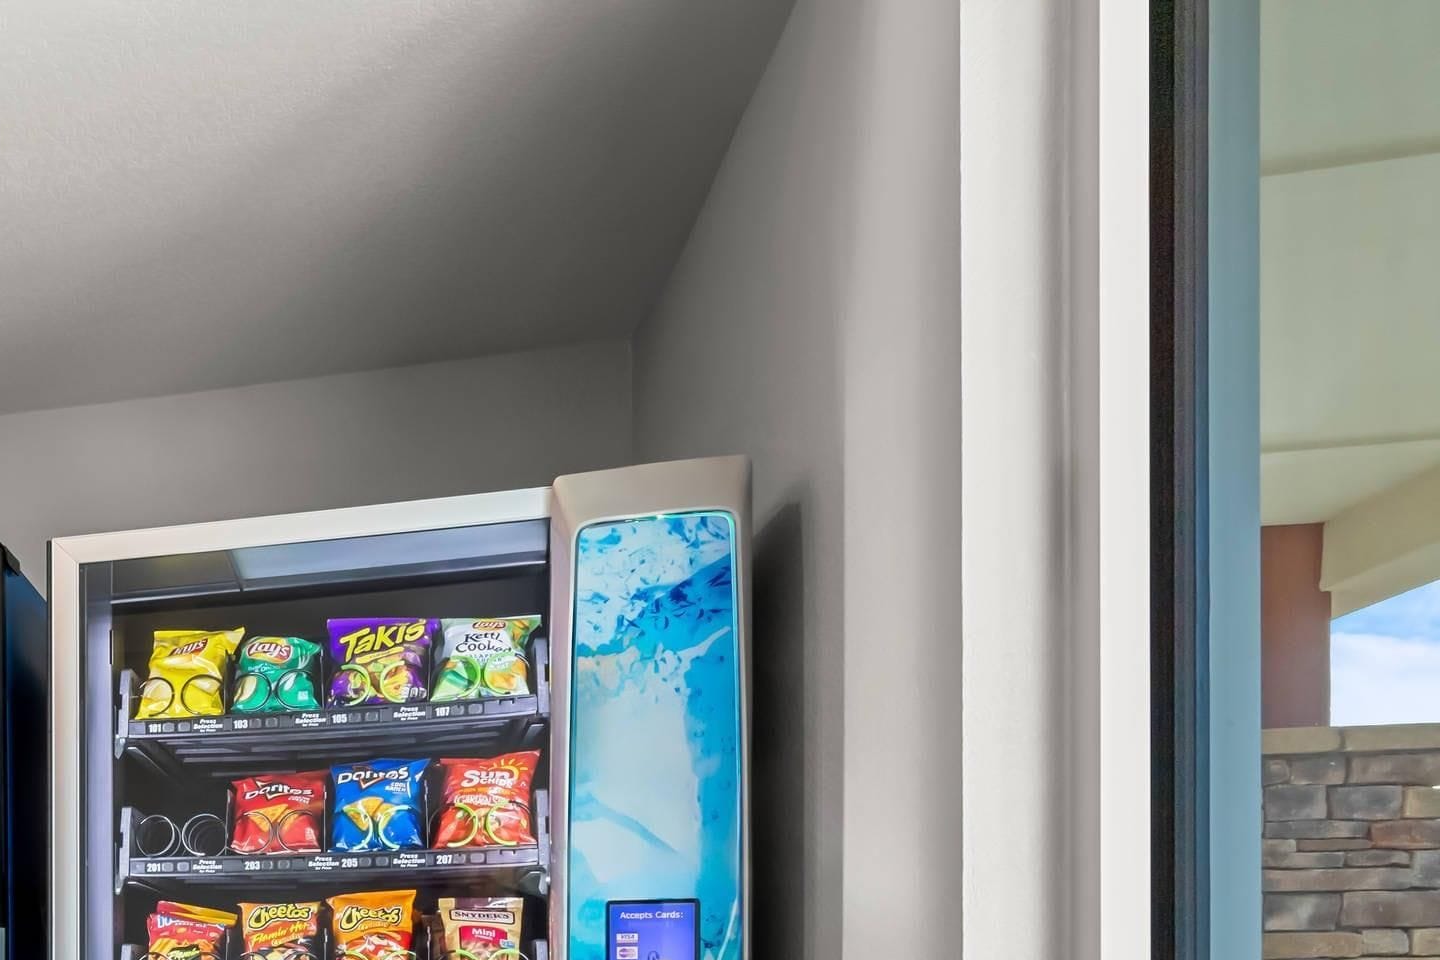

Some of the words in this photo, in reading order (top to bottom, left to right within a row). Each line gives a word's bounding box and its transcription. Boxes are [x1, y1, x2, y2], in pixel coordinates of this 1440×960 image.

[340, 621, 425, 662] Takis
[248, 641, 291, 660] Lay's
[435, 707, 450, 716] 107
[332, 714, 347, 724] 105
[148, 724, 162, 733] 101
[234, 720, 248, 729] 103
[338, 765, 409, 788] Doritos
[341, 858, 358, 868] 205
[436, 854, 452, 864] 207
[146, 864, 160, 872] 201
[244, 862, 260, 870] 203
[249, 904, 312, 929] Cheetos
[340, 906, 401, 931] Cheetos
[620, 911, 652, 920] Accepts
[655, 911, 684, 919] Cards:
[472, 927, 496, 938] Mini
